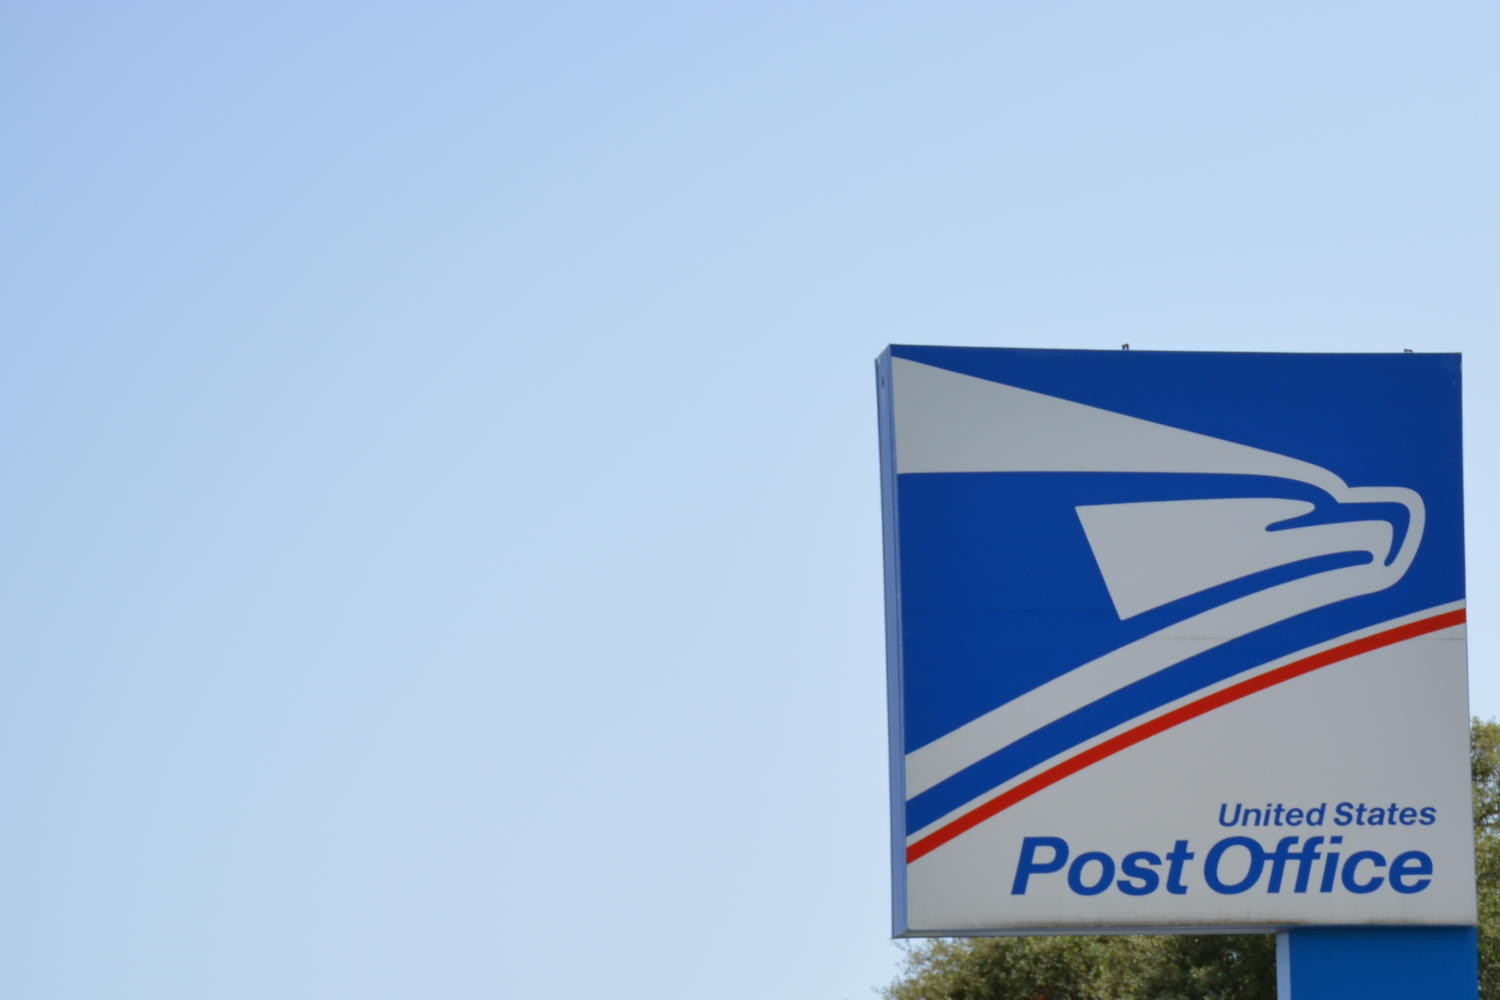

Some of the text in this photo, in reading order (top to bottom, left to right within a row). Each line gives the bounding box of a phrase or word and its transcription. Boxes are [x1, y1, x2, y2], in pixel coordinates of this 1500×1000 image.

[1217, 801, 1437, 827] United States
[1010, 835, 1433, 896] Post Office
